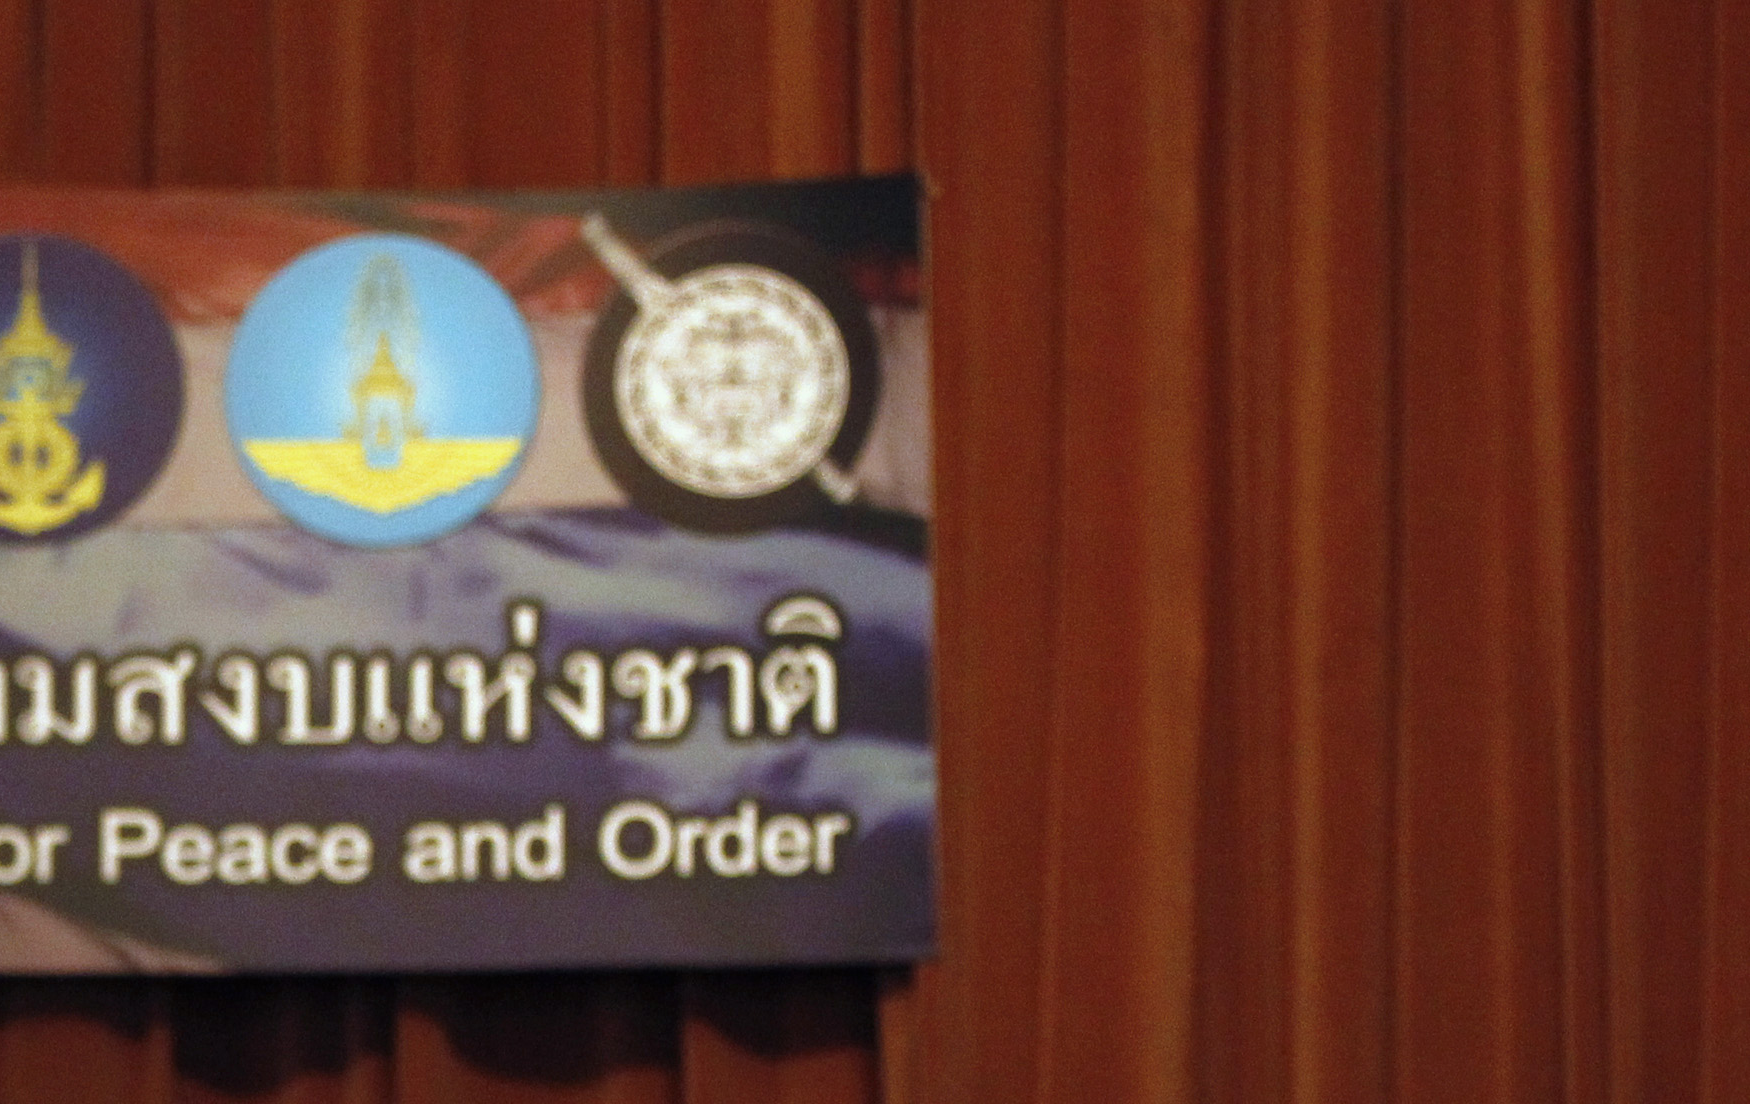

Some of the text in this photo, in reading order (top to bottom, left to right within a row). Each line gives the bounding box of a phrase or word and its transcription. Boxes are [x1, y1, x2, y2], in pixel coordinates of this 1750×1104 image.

[100, 808, 372, 884] Peace
[403, 806, 566, 882] and
[599, 801, 847, 880] Order
